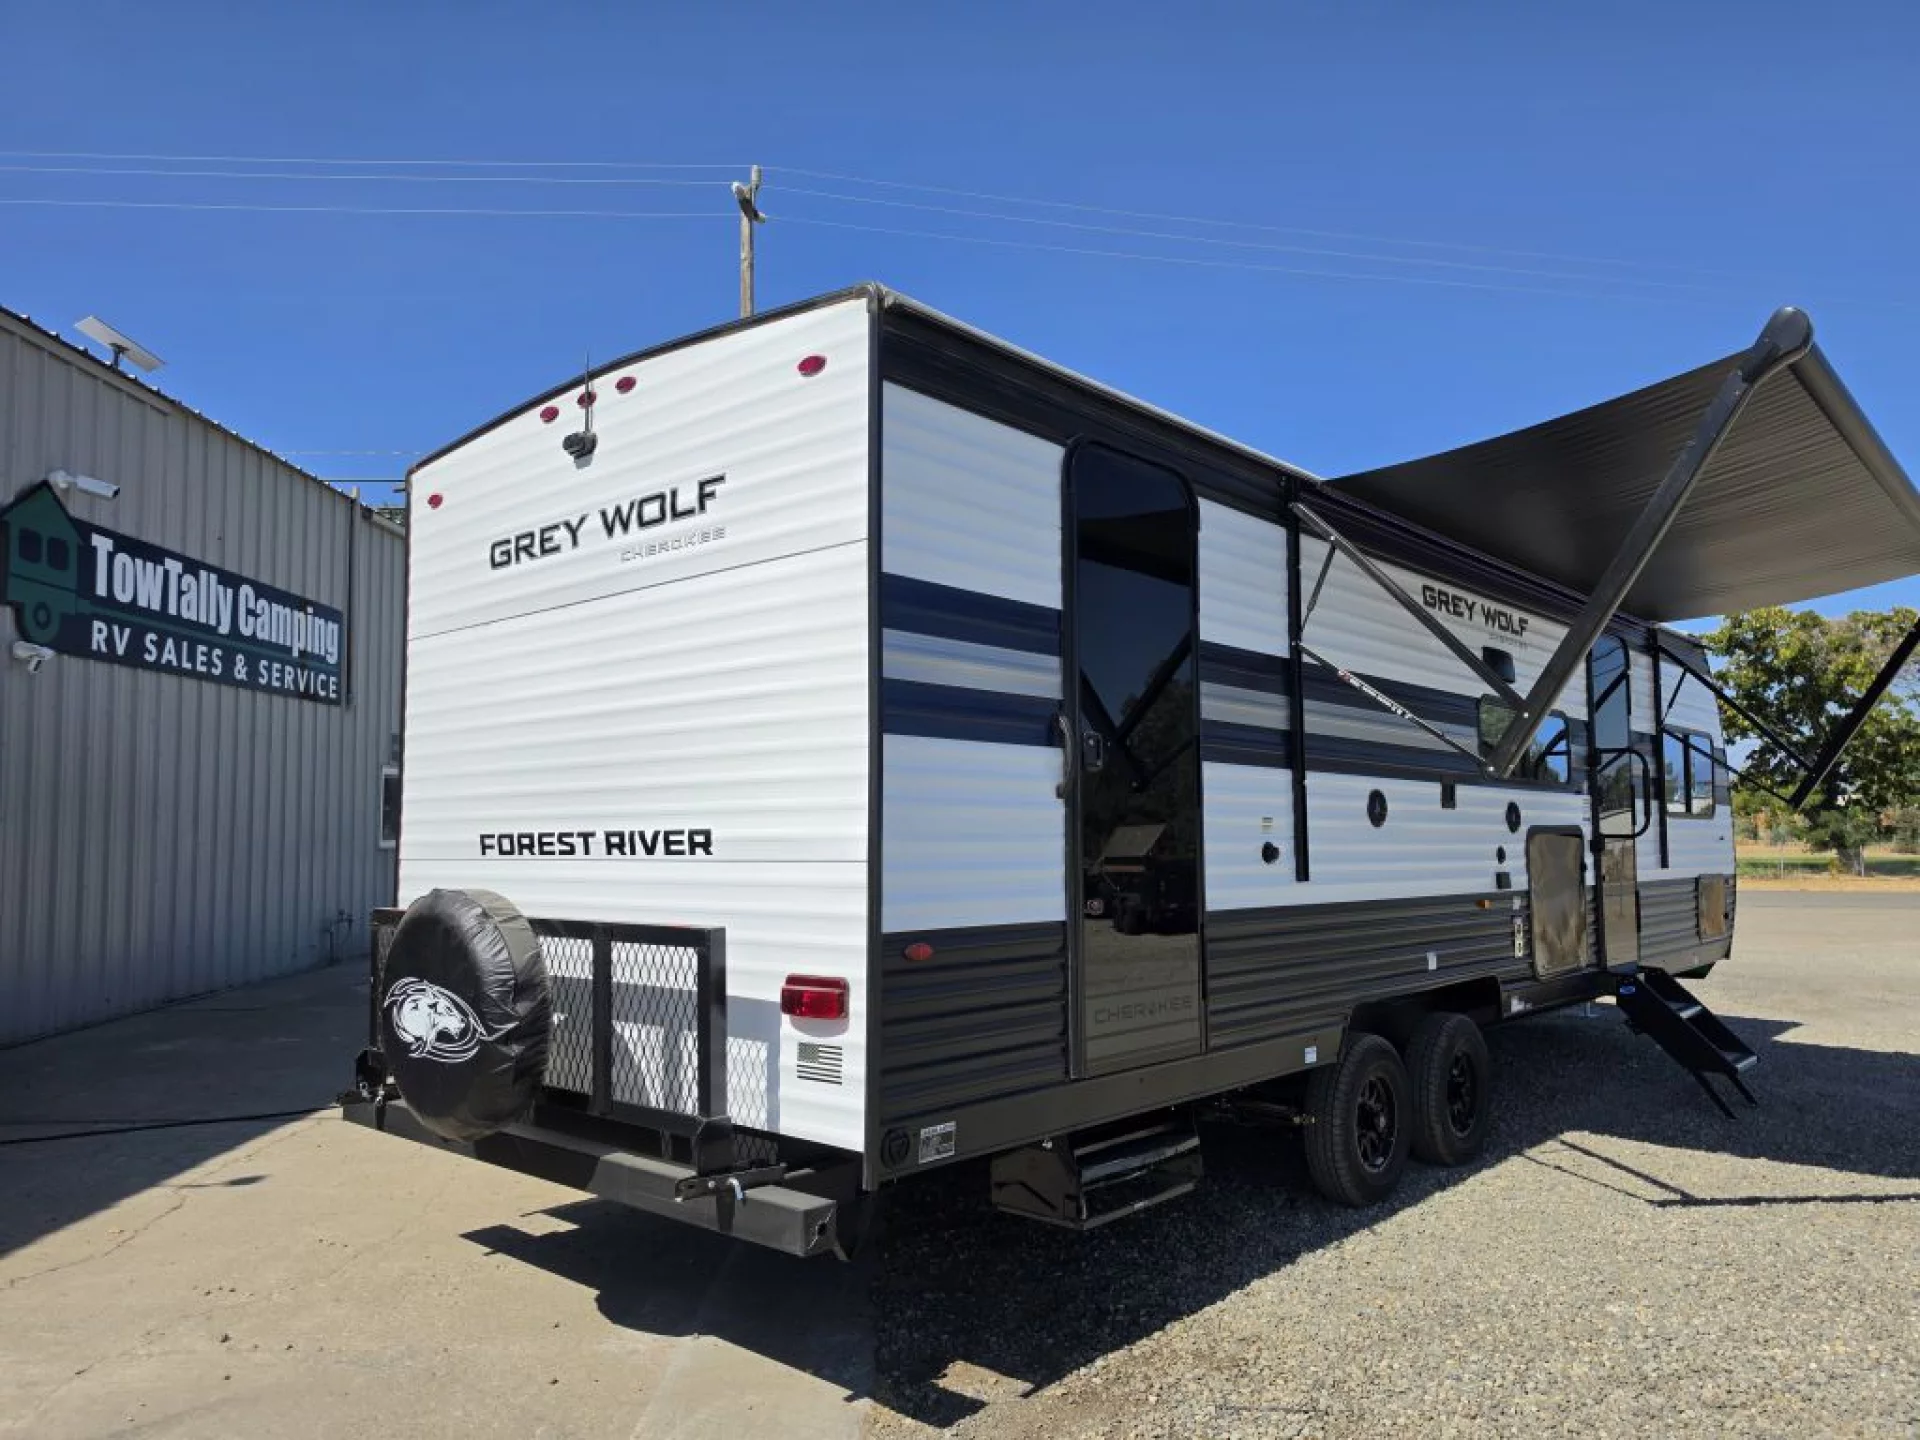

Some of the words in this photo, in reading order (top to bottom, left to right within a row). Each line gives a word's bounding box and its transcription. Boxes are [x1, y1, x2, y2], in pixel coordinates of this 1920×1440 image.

[490, 513, 589, 570] GREY
[599, 472, 726, 539] WOLF
[621, 526, 726, 562] CHEROKEE
[91, 532, 233, 635] TowTally
[239, 585, 340, 665] Camping
[1422, 584, 1476, 621] GREY
[1481, 603, 1528, 637] WOLF
[91, 620, 131, 656] RV
[144, 632, 223, 676] SALES
[233, 653, 248, 681] &
[258, 660, 338, 698] SERVICE
[479, 831, 596, 856] FOREST
[604, 828, 713, 856] RIVER
